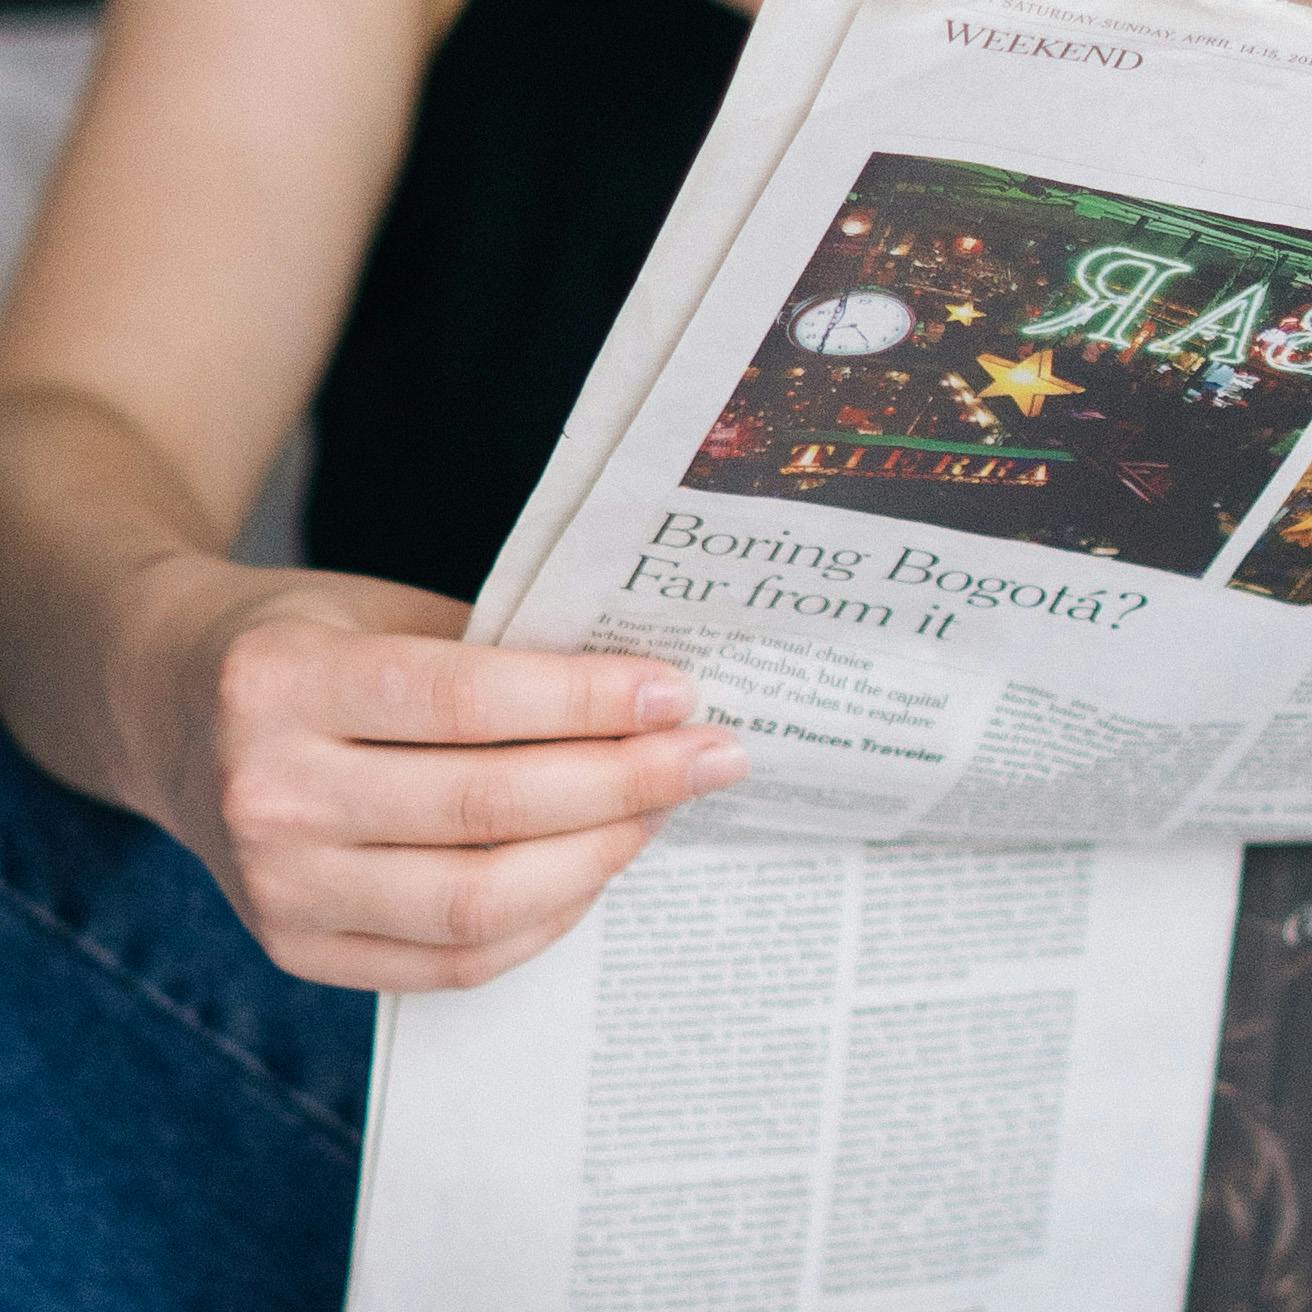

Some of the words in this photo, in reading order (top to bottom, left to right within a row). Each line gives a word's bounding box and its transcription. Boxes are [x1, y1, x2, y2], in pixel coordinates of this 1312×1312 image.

[944, 19, 1145, 72] WEEKEND
[1183, 34, 1232, 49] APRIL
[620, 554, 730, 602] Far
[744, 574, 895, 627] from
[914, 603, 963, 642] it
[648, 511, 871, 581] Boring
[886, 546, 1149, 630] Bogotá?
[648, 637, 712, 660] visiting
[717, 645, 811, 682] Colombia,
[817, 669, 850, 689] but
[853, 676, 884, 698] the
[886, 688, 949, 711] capital
[698, 624, 721, 638] be
[726, 628, 760, 642] the
[761, 635, 812, 658] usual
[815, 646, 874, 672] choice
[699, 664, 755, 694] plenty
[761, 682, 784, 700] of
[785, 687, 840, 713] riches
[846, 699, 864, 716] to
[867, 706, 937, 731] explore
[704, 705, 744, 729] The
[748, 717, 778, 736] 52
[782, 723, 853, 751] Places
[861, 738, 945, 765] Traveler
